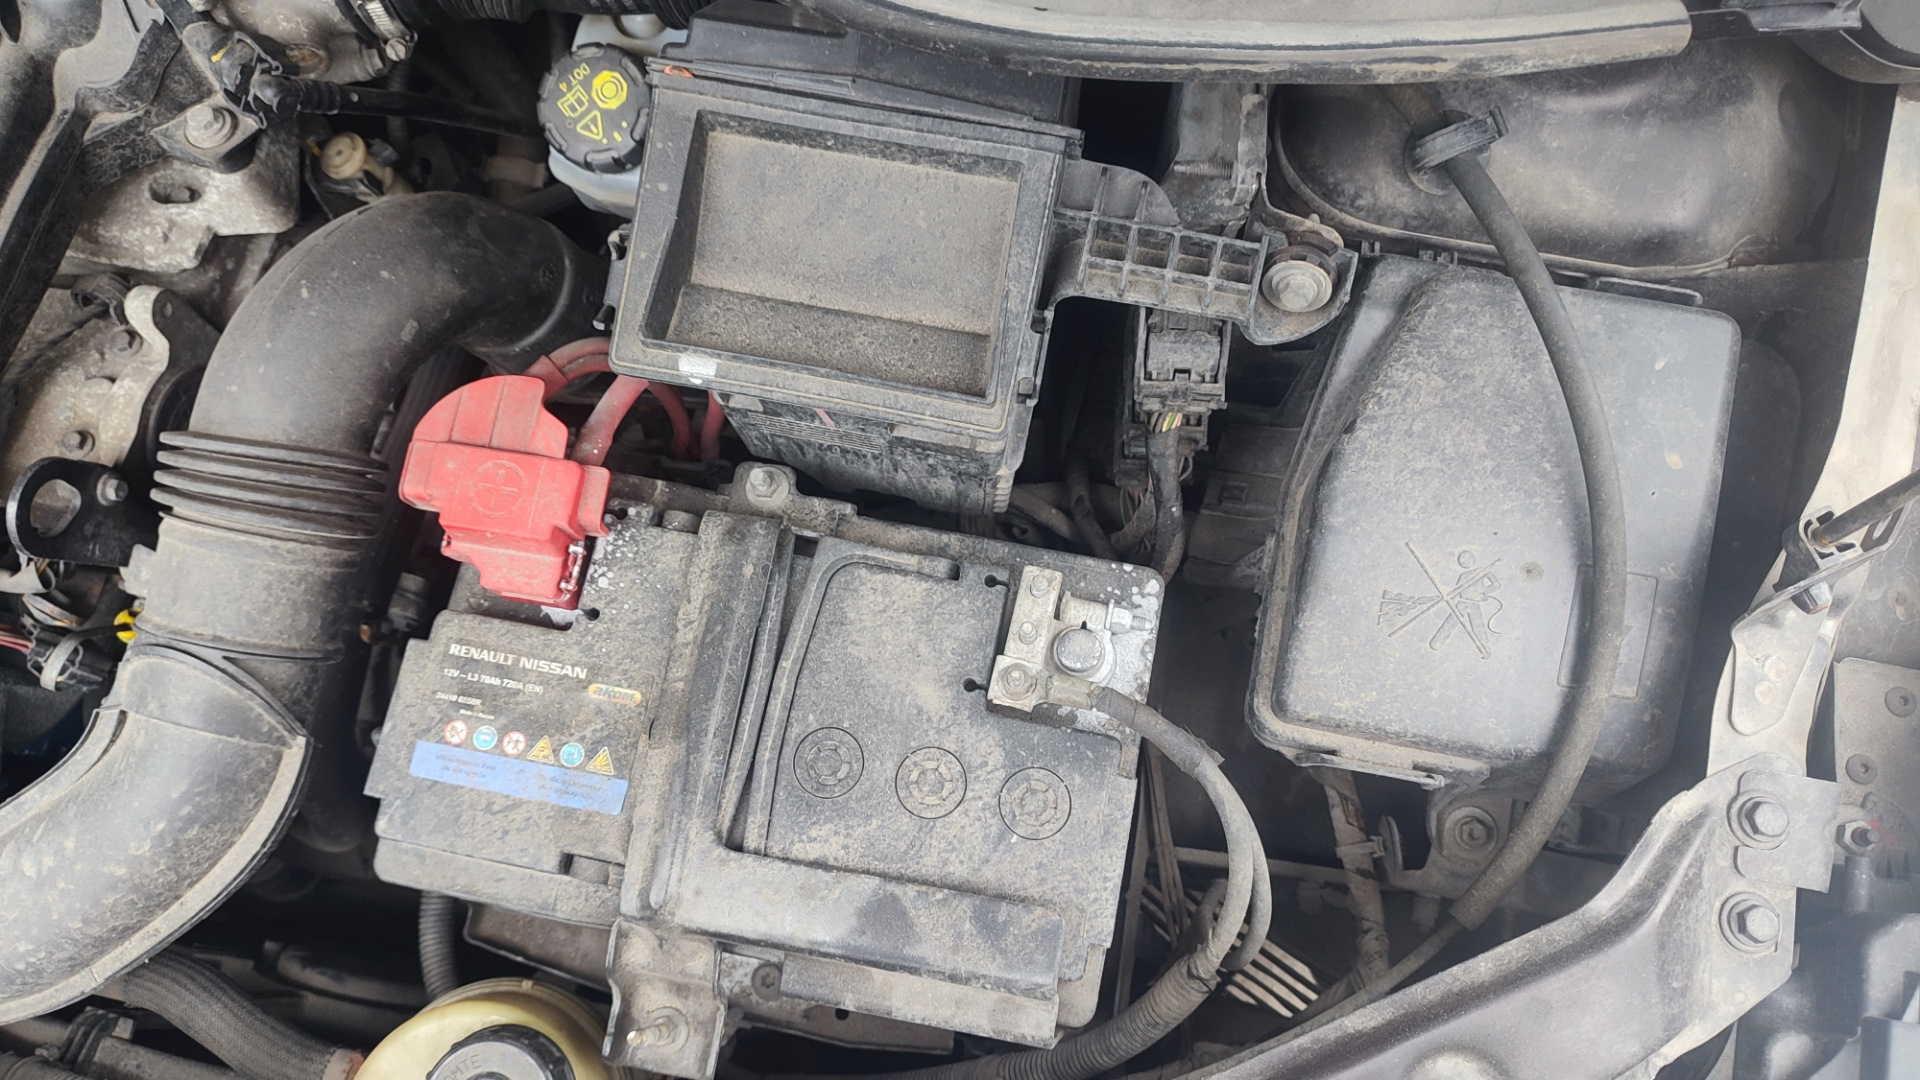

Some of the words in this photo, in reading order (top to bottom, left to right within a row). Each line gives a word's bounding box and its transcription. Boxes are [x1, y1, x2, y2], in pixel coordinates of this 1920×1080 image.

[558, 81, 568, 93] 4
[568, 62, 591, 87] DOT
[448, 643, 517, 665] RENAULT
[518, 656, 588, 680] NISSAN
[443, 668, 460, 678] 12V
[502, 678, 524, 690] 720A
[525, 683, 544, 695] (EN)
